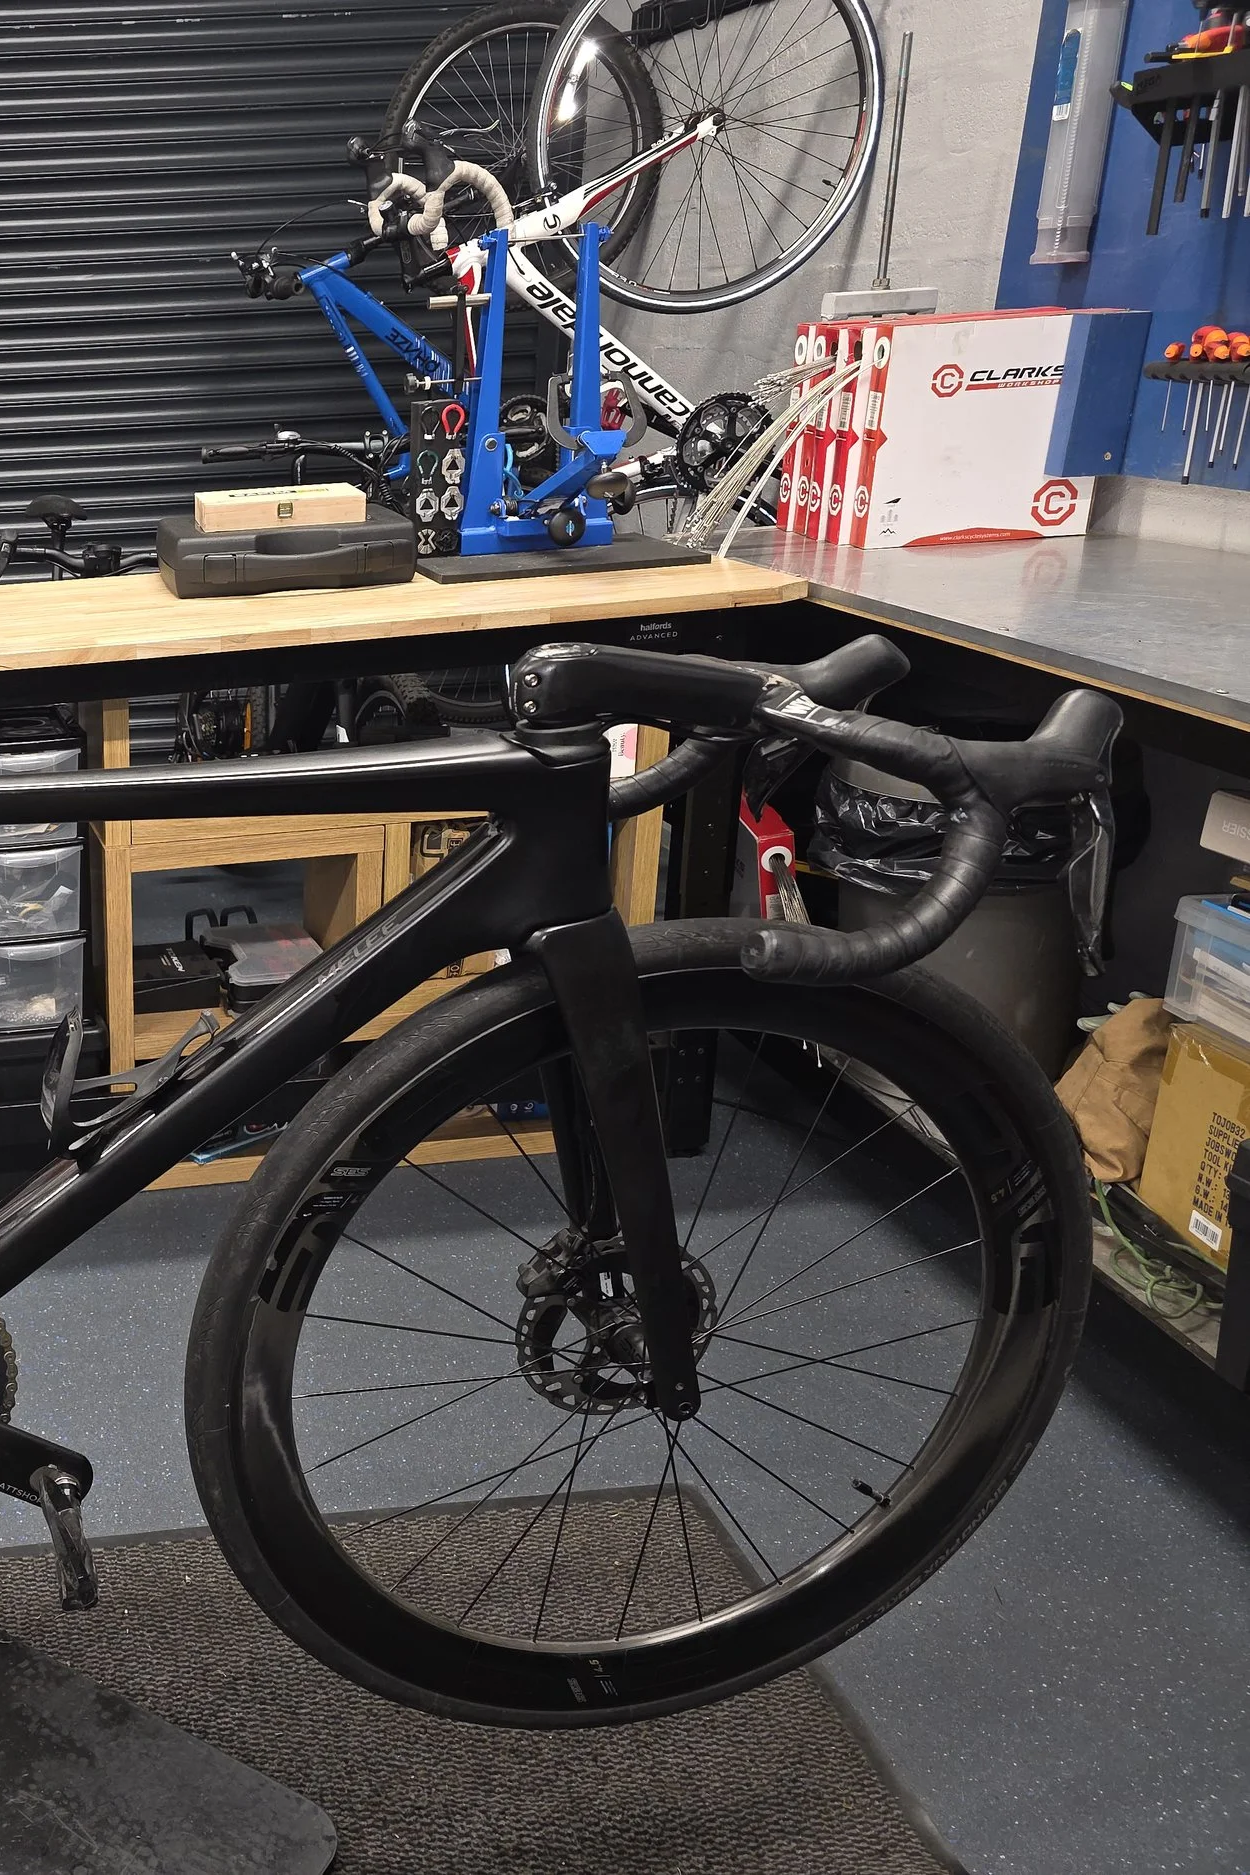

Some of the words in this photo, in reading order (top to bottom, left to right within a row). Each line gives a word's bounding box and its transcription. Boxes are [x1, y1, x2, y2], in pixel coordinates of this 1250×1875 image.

[970, 365, 1064, 382] CLARKS
[640, 622, 672, 631] halfords
[630, 631, 678, 641] ADVANCED
[1212, 1112, 1246, 1139] TOJOB32
[1203, 1149, 1221, 1168] TOOL
[1192, 1196, 1213, 1217] MADE
[1214, 1211, 1223, 1223] IN
